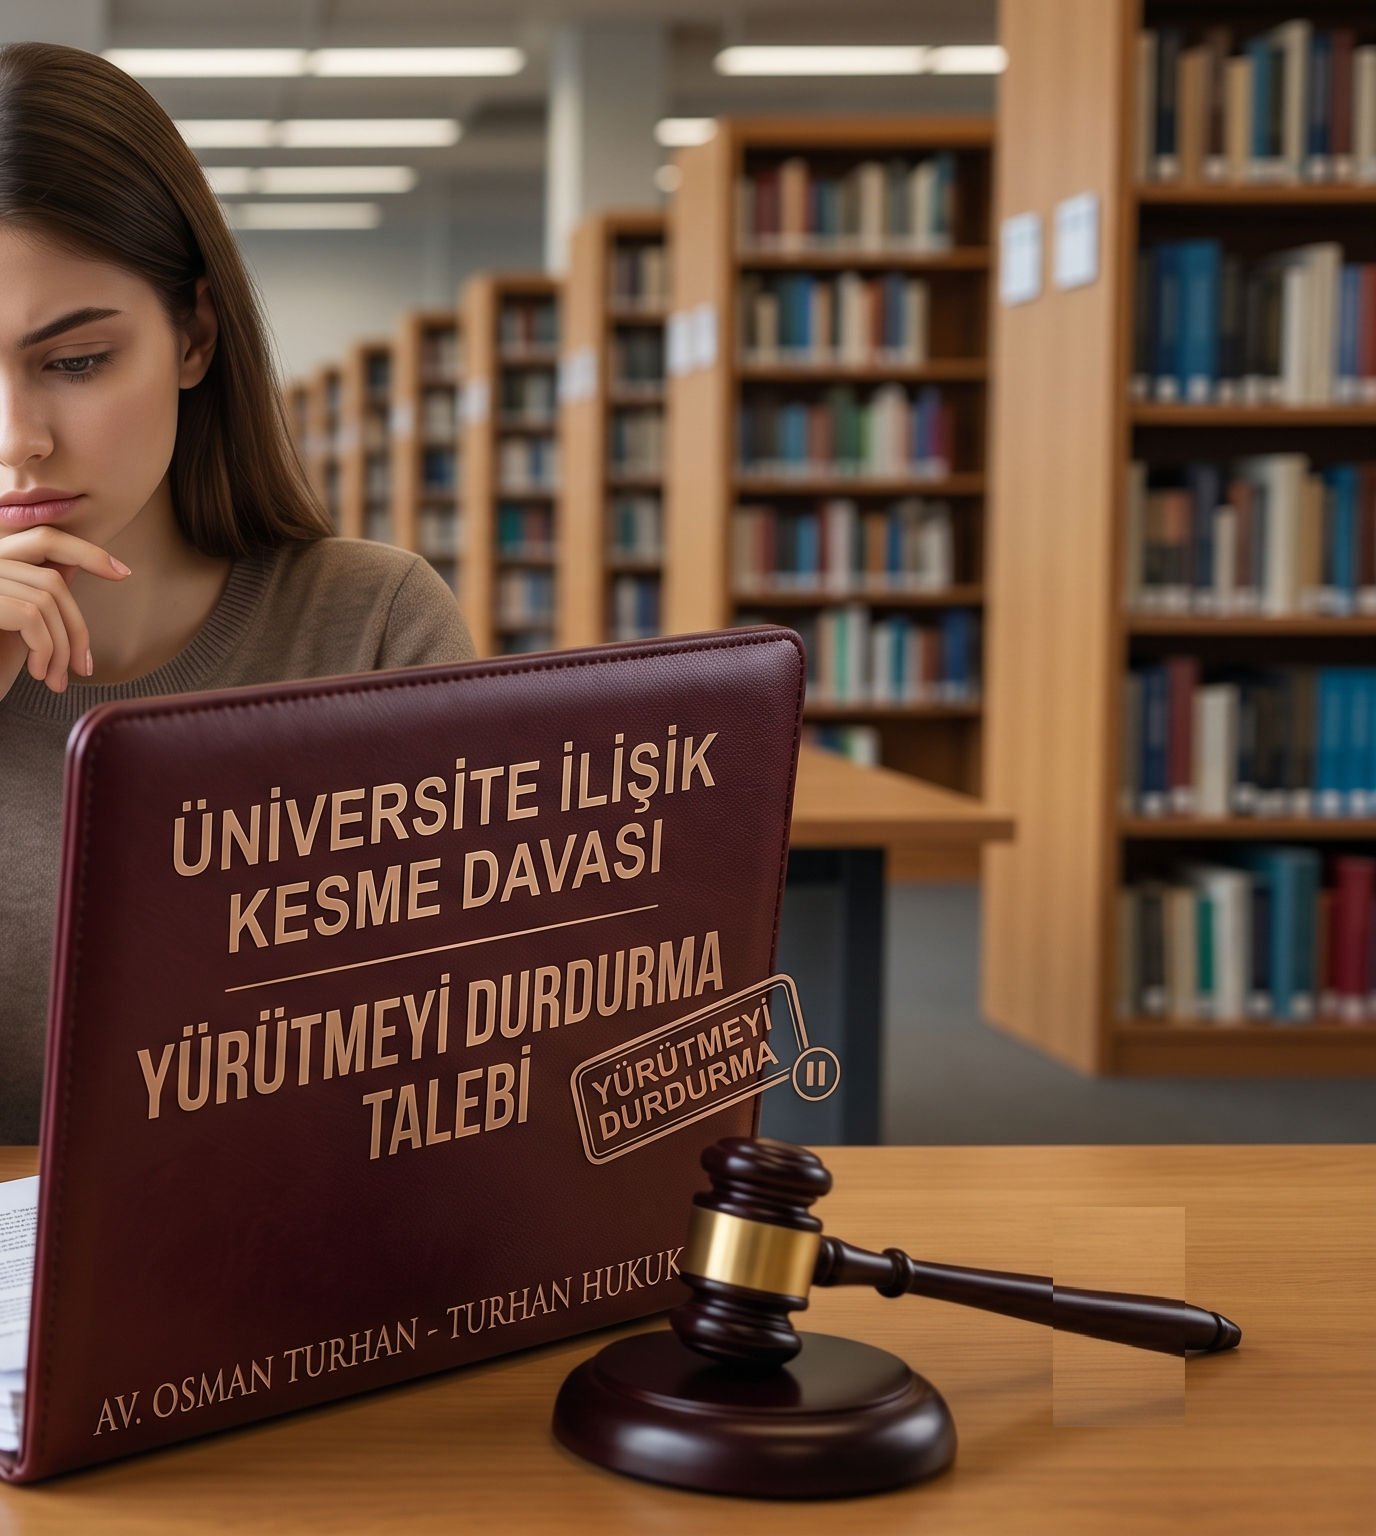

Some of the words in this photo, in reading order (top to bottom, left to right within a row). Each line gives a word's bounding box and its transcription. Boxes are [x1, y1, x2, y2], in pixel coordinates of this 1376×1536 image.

[173, 757, 541, 877] ÜNİVERSİTE
[560, 724, 719, 815] İLİŞİK
[228, 857, 442, 954] KESME
[462, 818, 663, 910] DAVASI
[136, 973, 450, 1120] YÜRÜTMEYİ
[465, 930, 724, 1048] DURDURMA
[591, 997, 773, 1105] YÜRÜTMEYİ
[598, 1041, 780, 1141] DURDURMA
[362, 1044, 531, 1160] TALEBİ
[93, 1391, 142, 1437] AV.
[152, 1355, 274, 1418] OSMAN
[283, 1317, 418, 1383] TURHAN
[446, 1276, 573, 1339] TURHAN
[580, 1246, 685, 1304] HUKUK
